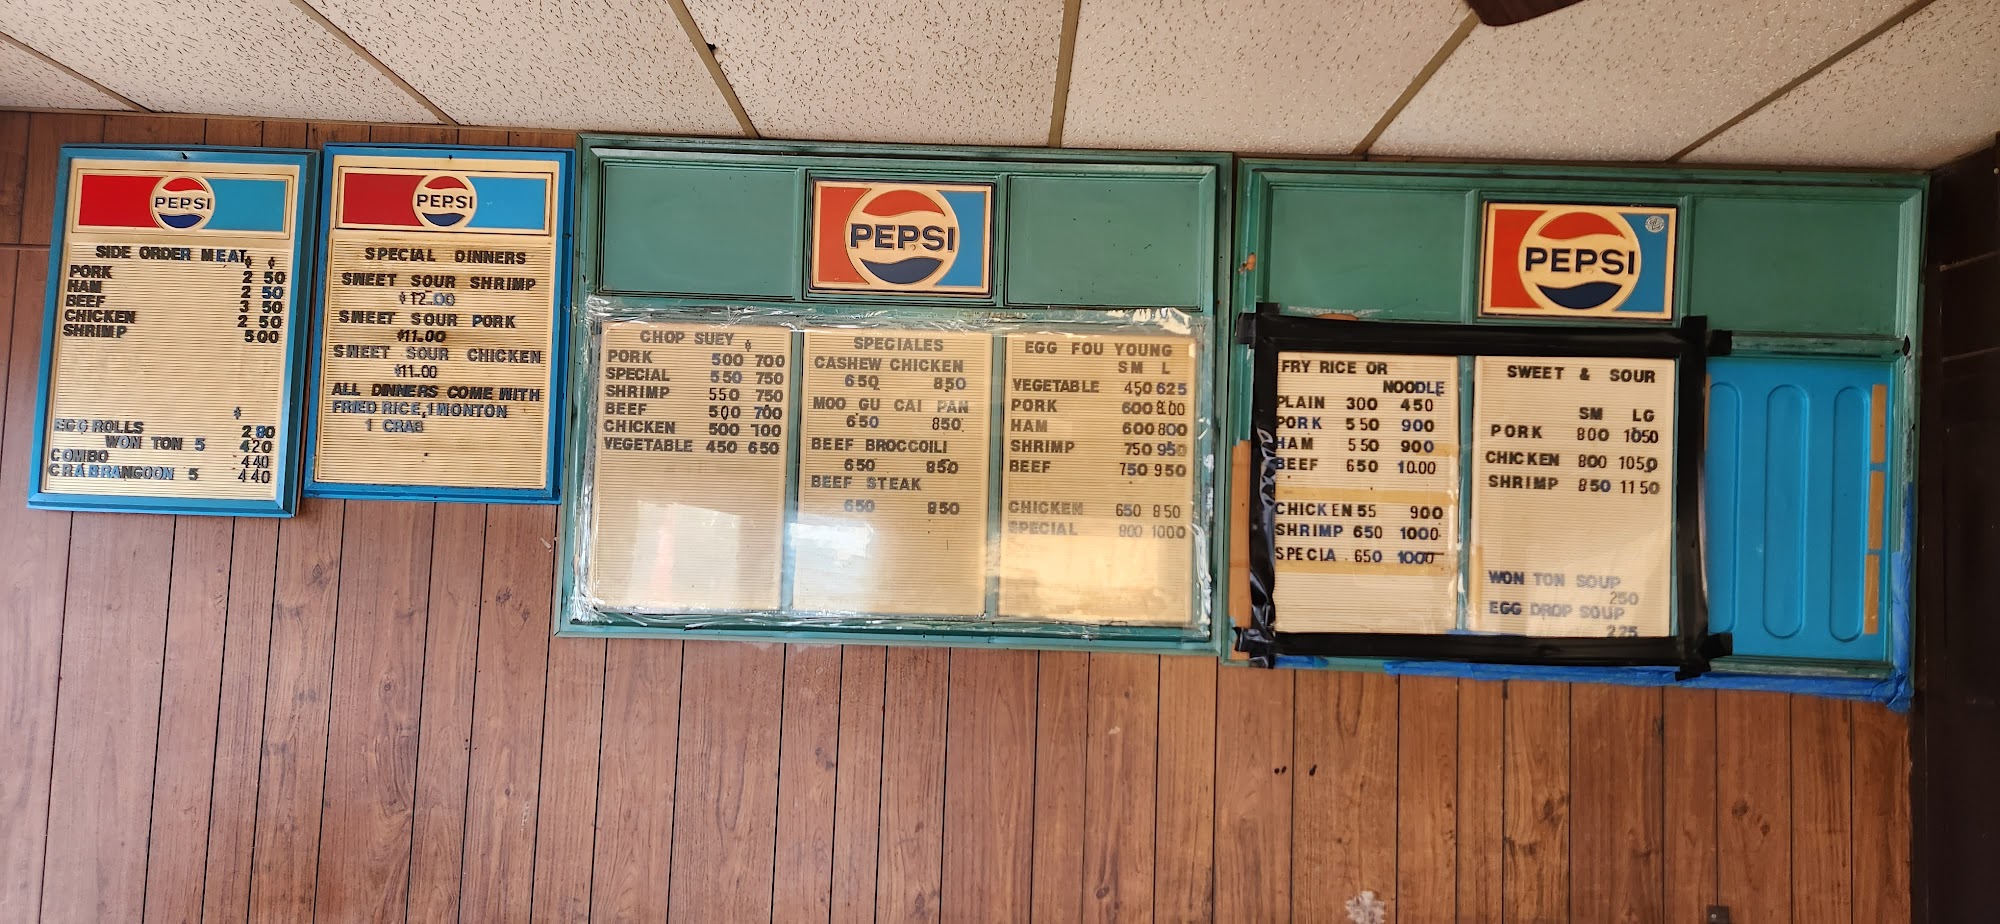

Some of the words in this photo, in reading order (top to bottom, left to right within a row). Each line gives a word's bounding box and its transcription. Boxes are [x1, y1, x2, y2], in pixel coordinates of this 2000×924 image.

[155, 196, 212, 210] PEPSI
[416, 194, 473, 209] PEPSI
[851, 223, 955, 251] PEPSI
[96, 246, 131, 259] SIDE
[139, 247, 191, 260] ORDER
[201, 249, 248, 262] MEAT
[365, 248, 435, 262] SPECIAL
[455, 250, 526, 264] DINNERS
[1525, 247, 1634, 275] PEPSI
[70, 265, 112, 278] PORK
[243, 272, 252, 283] 2
[264, 272, 285, 284] 50
[342, 272, 397, 286] SWEET
[410, 275, 456, 288] SOUR
[470, 277, 536, 290] SHRIMP
[67, 280, 102, 293] HAM
[241, 286, 250, 298] 2
[262, 286, 283, 299] 50
[66, 295, 105, 307] BEEF
[240, 301, 249, 312] 3
[262, 301, 282, 313] 50
[64, 310, 136, 323] CHICKEN
[237, 316, 247, 327] 2
[259, 316, 281, 328] 50
[339, 310, 395, 324] SWEET
[411, 313, 457, 326] SOUR
[472, 315, 515, 328] PORK
[63, 324, 127, 338] SHRIMP
[245, 331, 279, 343] 500
[640, 330, 685, 343] CHOP
[694, 332, 735, 345] SUEY
[854, 336, 944, 351] SPECIALES
[1025, 341, 1057, 354] EGG
[1072, 342, 1104, 355] FOU
[1114, 343, 1172, 356] YOUNG
[333, 345, 390, 359] SWEET
[406, 347, 449, 360] SOUR
[467, 348, 541, 364] CHICKEN
[607, 350, 652, 363] PORK
[711, 353, 744, 366] 500
[755, 354, 785, 367] 700
[814, 356, 881, 370] CASHEW
[890, 359, 964, 372] CHICKEN
[1162, 362, 1171, 374] L
[1282, 360, 1311, 372] FRY
[1320, 361, 1356, 373] RICE
[1366, 362, 1387, 374] OR
[605, 367, 670, 381] SPECIAL
[710, 371, 743, 384] 550
[756, 372, 783, 385] 750
[845, 374, 879, 388] 650
[934, 377, 966, 390] 850
[1507, 365, 1564, 380] SWEET
[1580, 368, 1590, 381] &
[1610, 369, 1655, 383] SOUR
[332, 383, 360, 395] ALL
[372, 384, 438, 397] DINNERS
[447, 386, 493, 399] COME
[499, 388, 540, 401] WITH
[605, 385, 670, 398] SHRIMP
[709, 388, 739, 401] 550
[756, 389, 783, 402] 750
[1013, 378, 1099, 393] VEGETABLE
[1124, 381, 1152, 395] 450
[1156, 382, 1187, 395] 625
[1383, 380, 1445, 396] NOODLE
[332, 400, 376, 414] FRIED
[605, 403, 647, 415] BEEF
[709, 405, 740, 420] 500
[754, 405, 782, 419] 700
[813, 397, 846, 410] MOO
[859, 398, 880, 411] GU
[894, 399, 922, 412] CAI
[937, 400, 969, 413] PAN
[1011, 399, 1057, 412] PORK
[1122, 401, 1153, 414] 600
[1277, 396, 1325, 409] PLAIN
[1346, 397, 1377, 411] 300
[1401, 399, 1433, 411] 450
[847, 415, 879, 428] 650
[932, 417, 961, 430] 850
[1579, 407, 1603, 420] SM
[1633, 409, 1654, 422] LG
[54, 419, 87, 432] EGG
[92, 420, 144, 433] ROLLS
[604, 419, 675, 434] CHICKEN
[709, 423, 740, 436] 500
[1011, 419, 1047, 432] HAM
[1122, 422, 1154, 435] 600
[1158, 423, 1187, 436] 800
[1276, 417, 1322, 429] PORK
[1346, 418, 1379, 431] 550
[1402, 419, 1434, 432] 900
[1491, 424, 1542, 439] PORK
[1577, 427, 1609, 441] 800
[1624, 428, 1659, 444] 1050
[106, 435, 141, 449] WON
[151, 437, 182, 450] TON
[195, 438, 205, 451] 5
[240, 440, 271, 453] 420
[604, 437, 692, 452] VEGETABLE
[706, 440, 737, 453] 450
[748, 442, 779, 454] 650
[811, 437, 853, 450] BEEF
[1011, 439, 1075, 453] SHRIMP
[1124, 443, 1152, 456] 750
[1276, 437, 1313, 450] HAM
[1348, 438, 1379, 451] 550
[1401, 440, 1434, 453] 900
[51, 449, 108, 462] COMBO
[1485, 451, 1560, 466] CHICKEN
[1578, 454, 1607, 469] 800
[844, 459, 875, 471] 650
[926, 460, 958, 474] 850
[1010, 460, 1051, 473] BEEF
[1120, 463, 1148, 476] 750
[1155, 464, 1186, 477] 950
[1276, 457, 1318, 470] BEEF
[1347, 459, 1378, 472] 650
[189, 468, 199, 480] 5
[811, 475, 852, 488] BEEF
[866, 477, 921, 490] STEAK
[1488, 475, 1558, 490] SHRIMP
[1579, 479, 1611, 492] 850
[1621, 480, 1660, 494] 1150
[844, 499, 875, 512] 650
[928, 501, 959, 515] 850
[1008, 501, 1083, 515] CHICKEN
[1116, 503, 1141, 517] 650
[1153, 504, 1180, 518] 850
[1275, 502, 1352, 516] CHICKEN
[1358, 505, 1376, 518] 55
[1410, 506, 1443, 519] 900
[1008, 521, 1078, 535] SPECIAL
[1152, 525, 1185, 539] 1000
[1275, 523, 1343, 537] SHRIMP
[1353, 525, 1382, 539] 650
[1400, 527, 1438, 541] 1000
[1275, 547, 1336, 561] SPECIA
[1355, 550, 1382, 563] 650
[1489, 570, 1525, 584] WON
[1534, 572, 1565, 586] TON
[1576, 574, 1621, 589] SOUP
[1610, 591, 1638, 605] 250
[1489, 601, 1522, 615] EGG
[1530, 603, 1573, 617] DROP
[1579, 605, 1625, 619] SOUP
